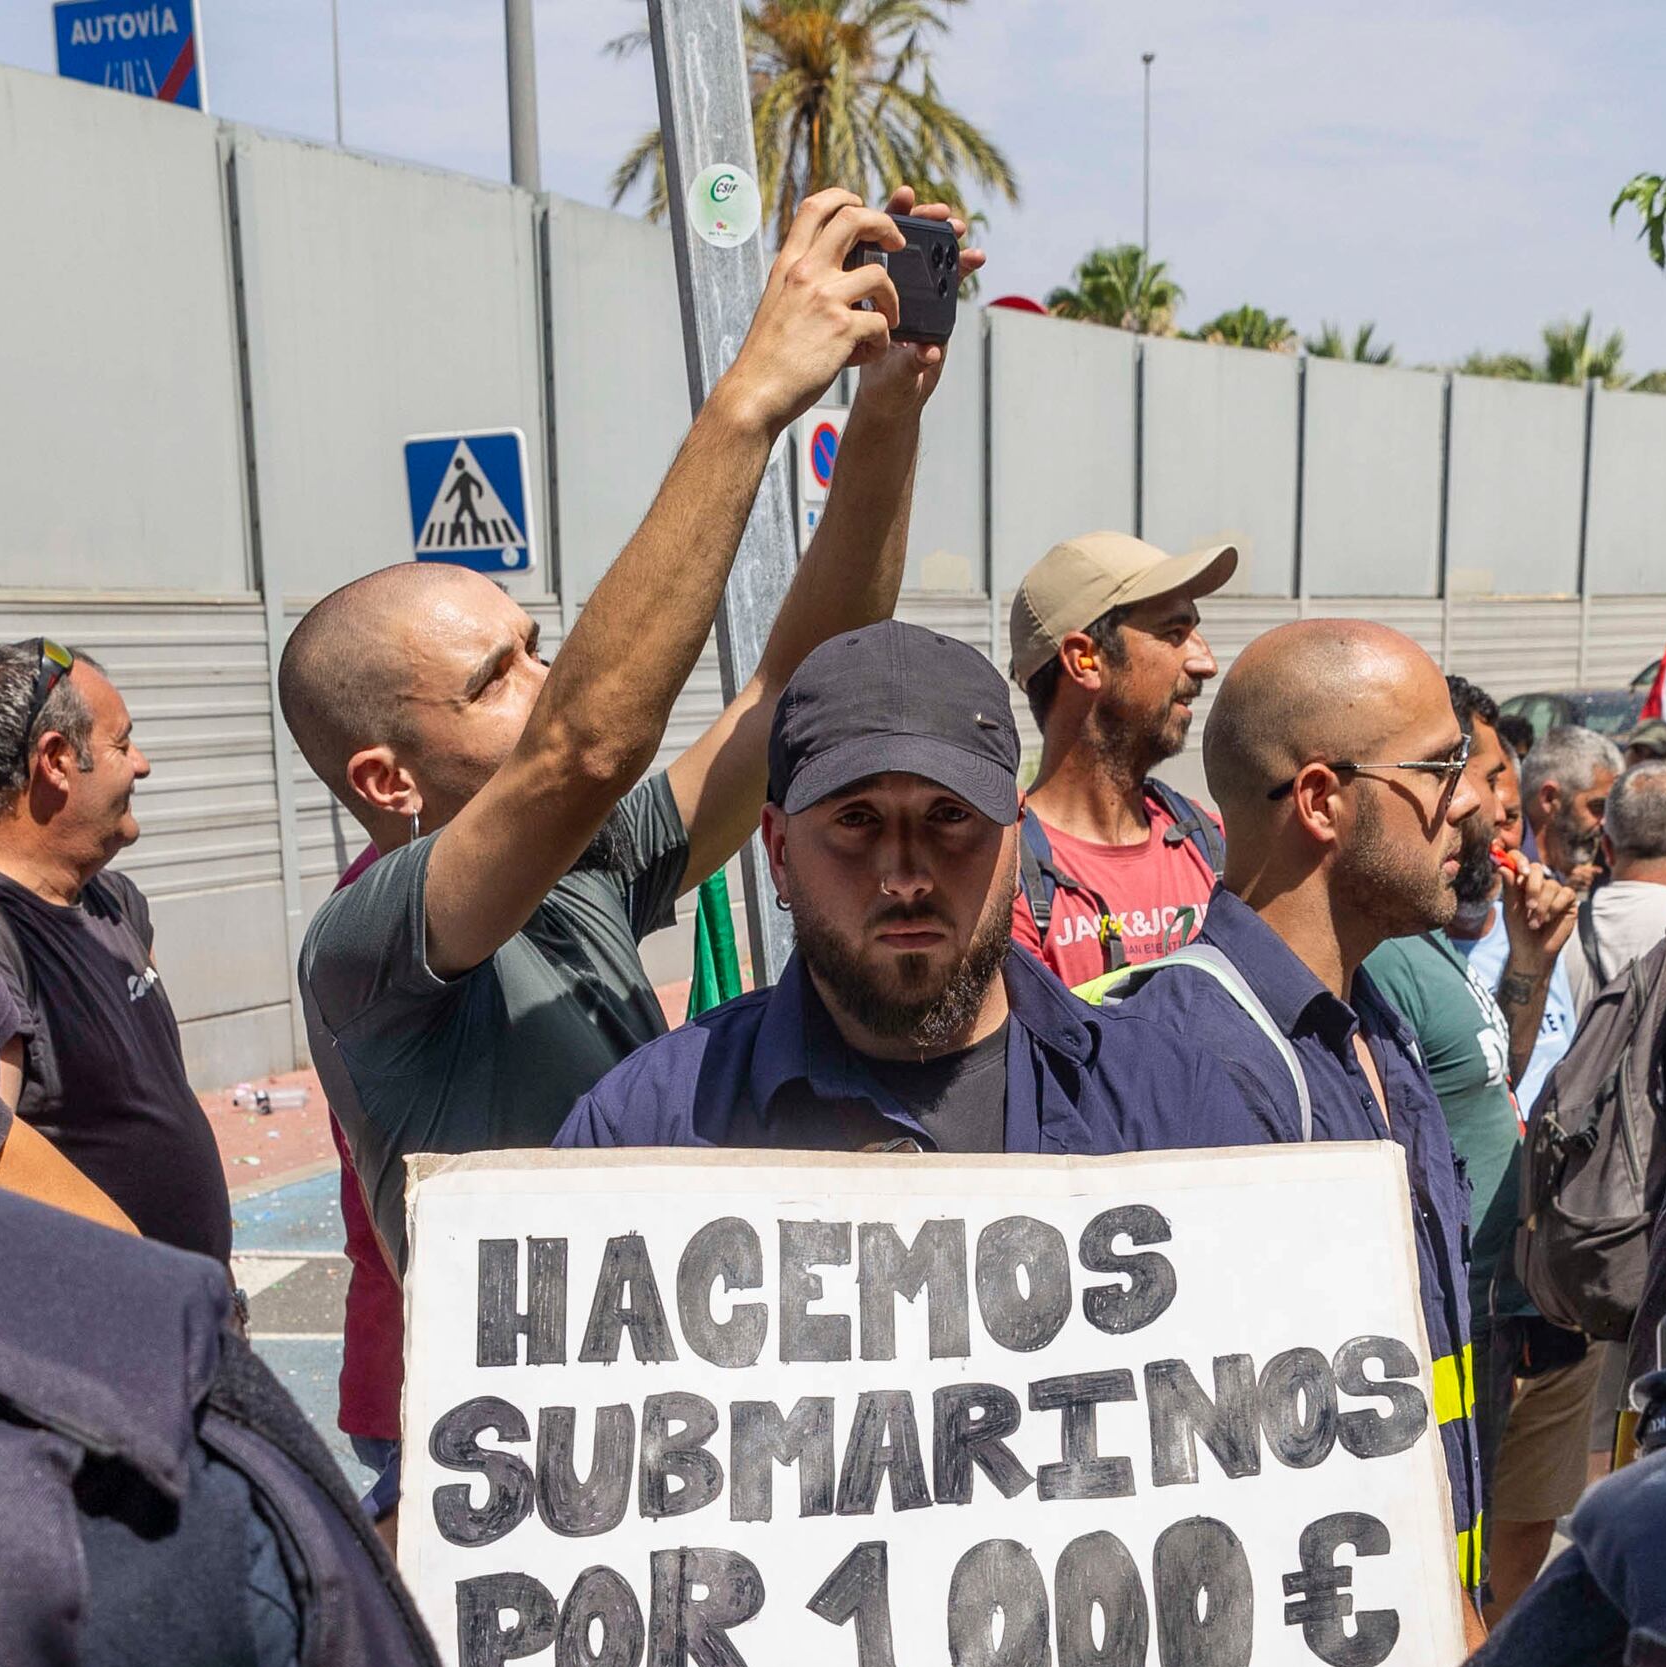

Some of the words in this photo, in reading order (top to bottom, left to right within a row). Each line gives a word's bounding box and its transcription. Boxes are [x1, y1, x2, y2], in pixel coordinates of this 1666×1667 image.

[71, 3, 179, 45] AUTOVÍA
[476, 1203, 1177, 1368] HACEMOS
[429, 1335, 1429, 1548] SUBMARINOS
